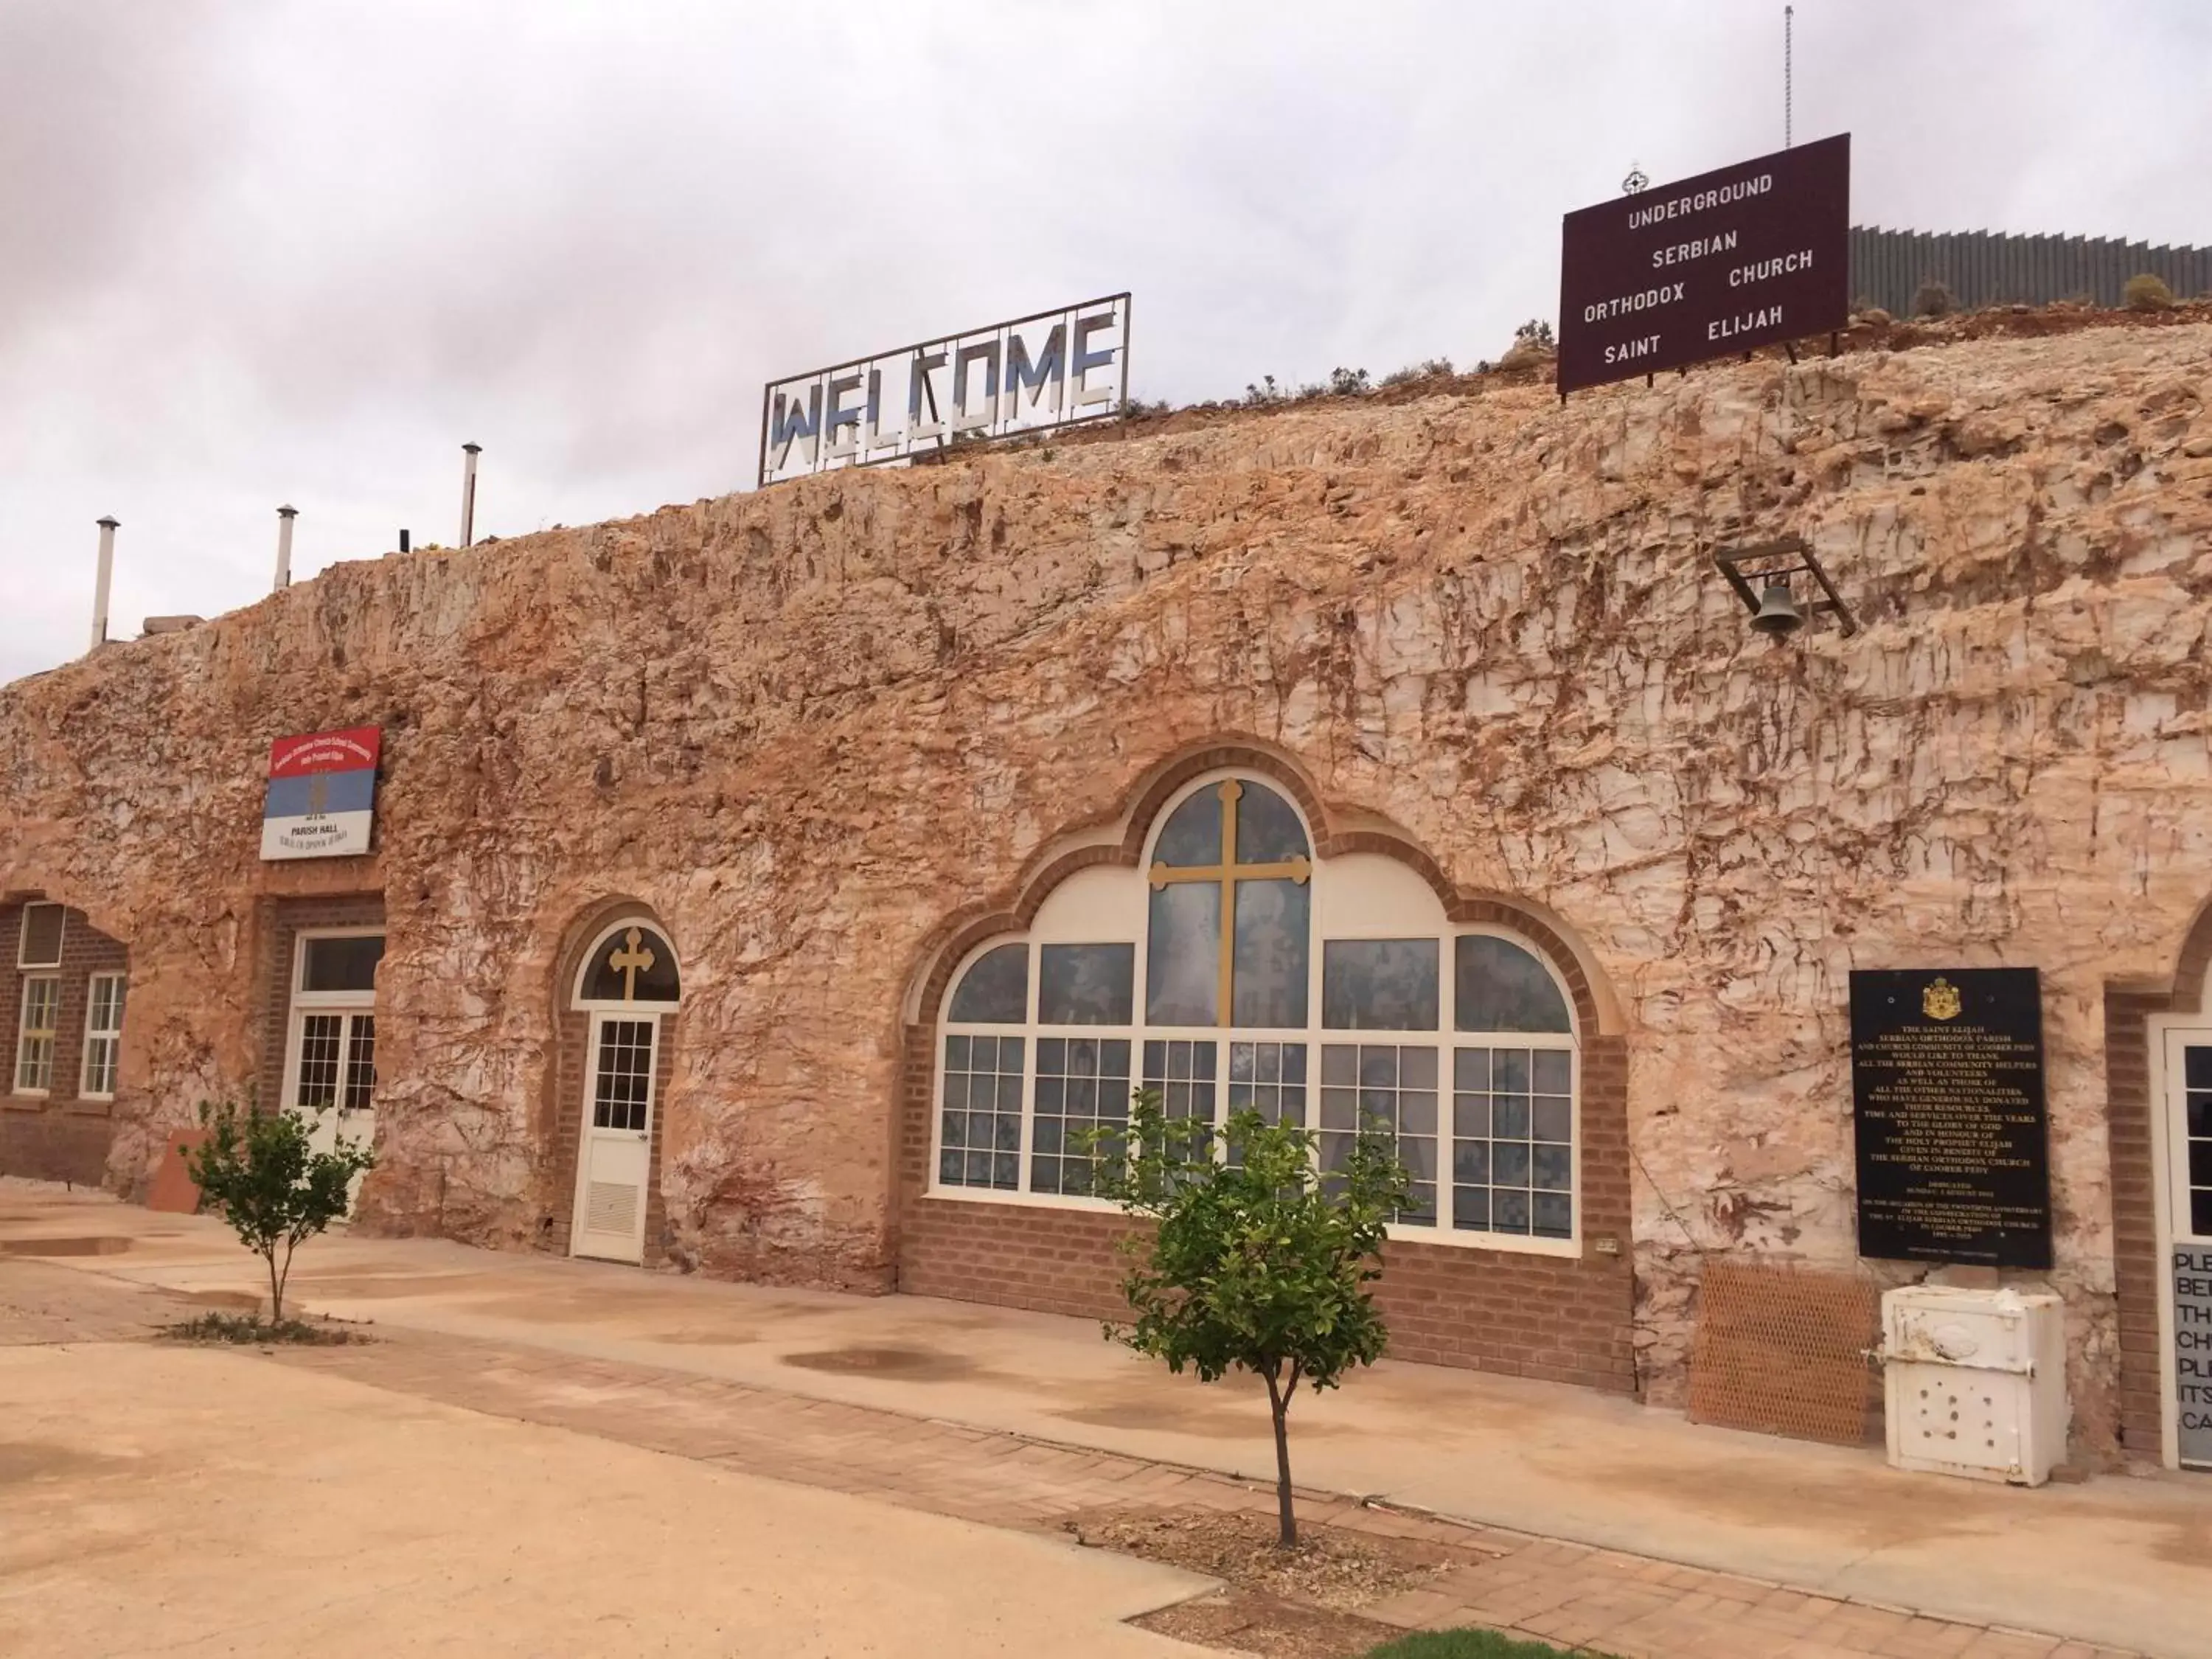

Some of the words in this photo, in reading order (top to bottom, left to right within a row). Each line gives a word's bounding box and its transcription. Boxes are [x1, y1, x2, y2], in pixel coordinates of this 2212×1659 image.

[1629, 174, 1773, 229] UNDERGROUND
[1652, 230, 1738, 268] SERBIAN
[1584, 282, 1686, 324] ORTHODOX
[1728, 249, 1813, 287] CHURCH
[1604, 335, 1661, 364] SAINT
[1708, 305, 1783, 341] ELIJAH
[771, 311, 1116, 471] WELCOME
[292, 827, 318, 835] PARISH
[320, 824, 338, 833] HALL
[1932, 1156, 1986, 1164] ORTHODOX
[1989, 1158, 2030, 1166] CHURCH
[1934, 1138, 1977, 1147] PROPHET
[1980, 1141, 2012, 1149] ELIJAH
[2180, 1385, 2212, 1404] ITS
